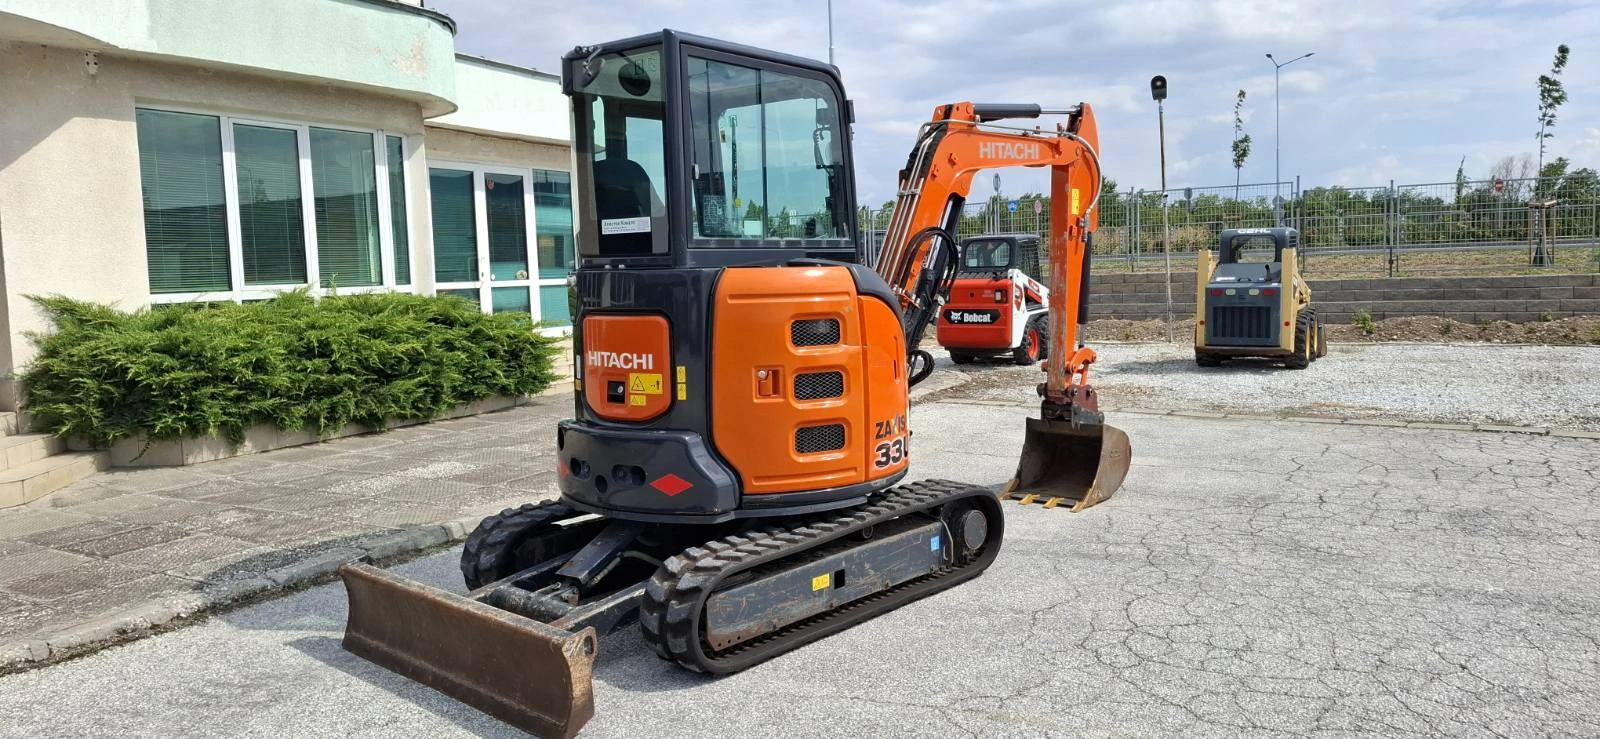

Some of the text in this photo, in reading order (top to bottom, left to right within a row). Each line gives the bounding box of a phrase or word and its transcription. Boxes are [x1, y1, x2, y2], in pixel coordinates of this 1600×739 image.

[979, 142, 1039, 160] HITACHI
[963, 313, 992, 323] Bobcat
[588, 350, 654, 370] HITACHI
